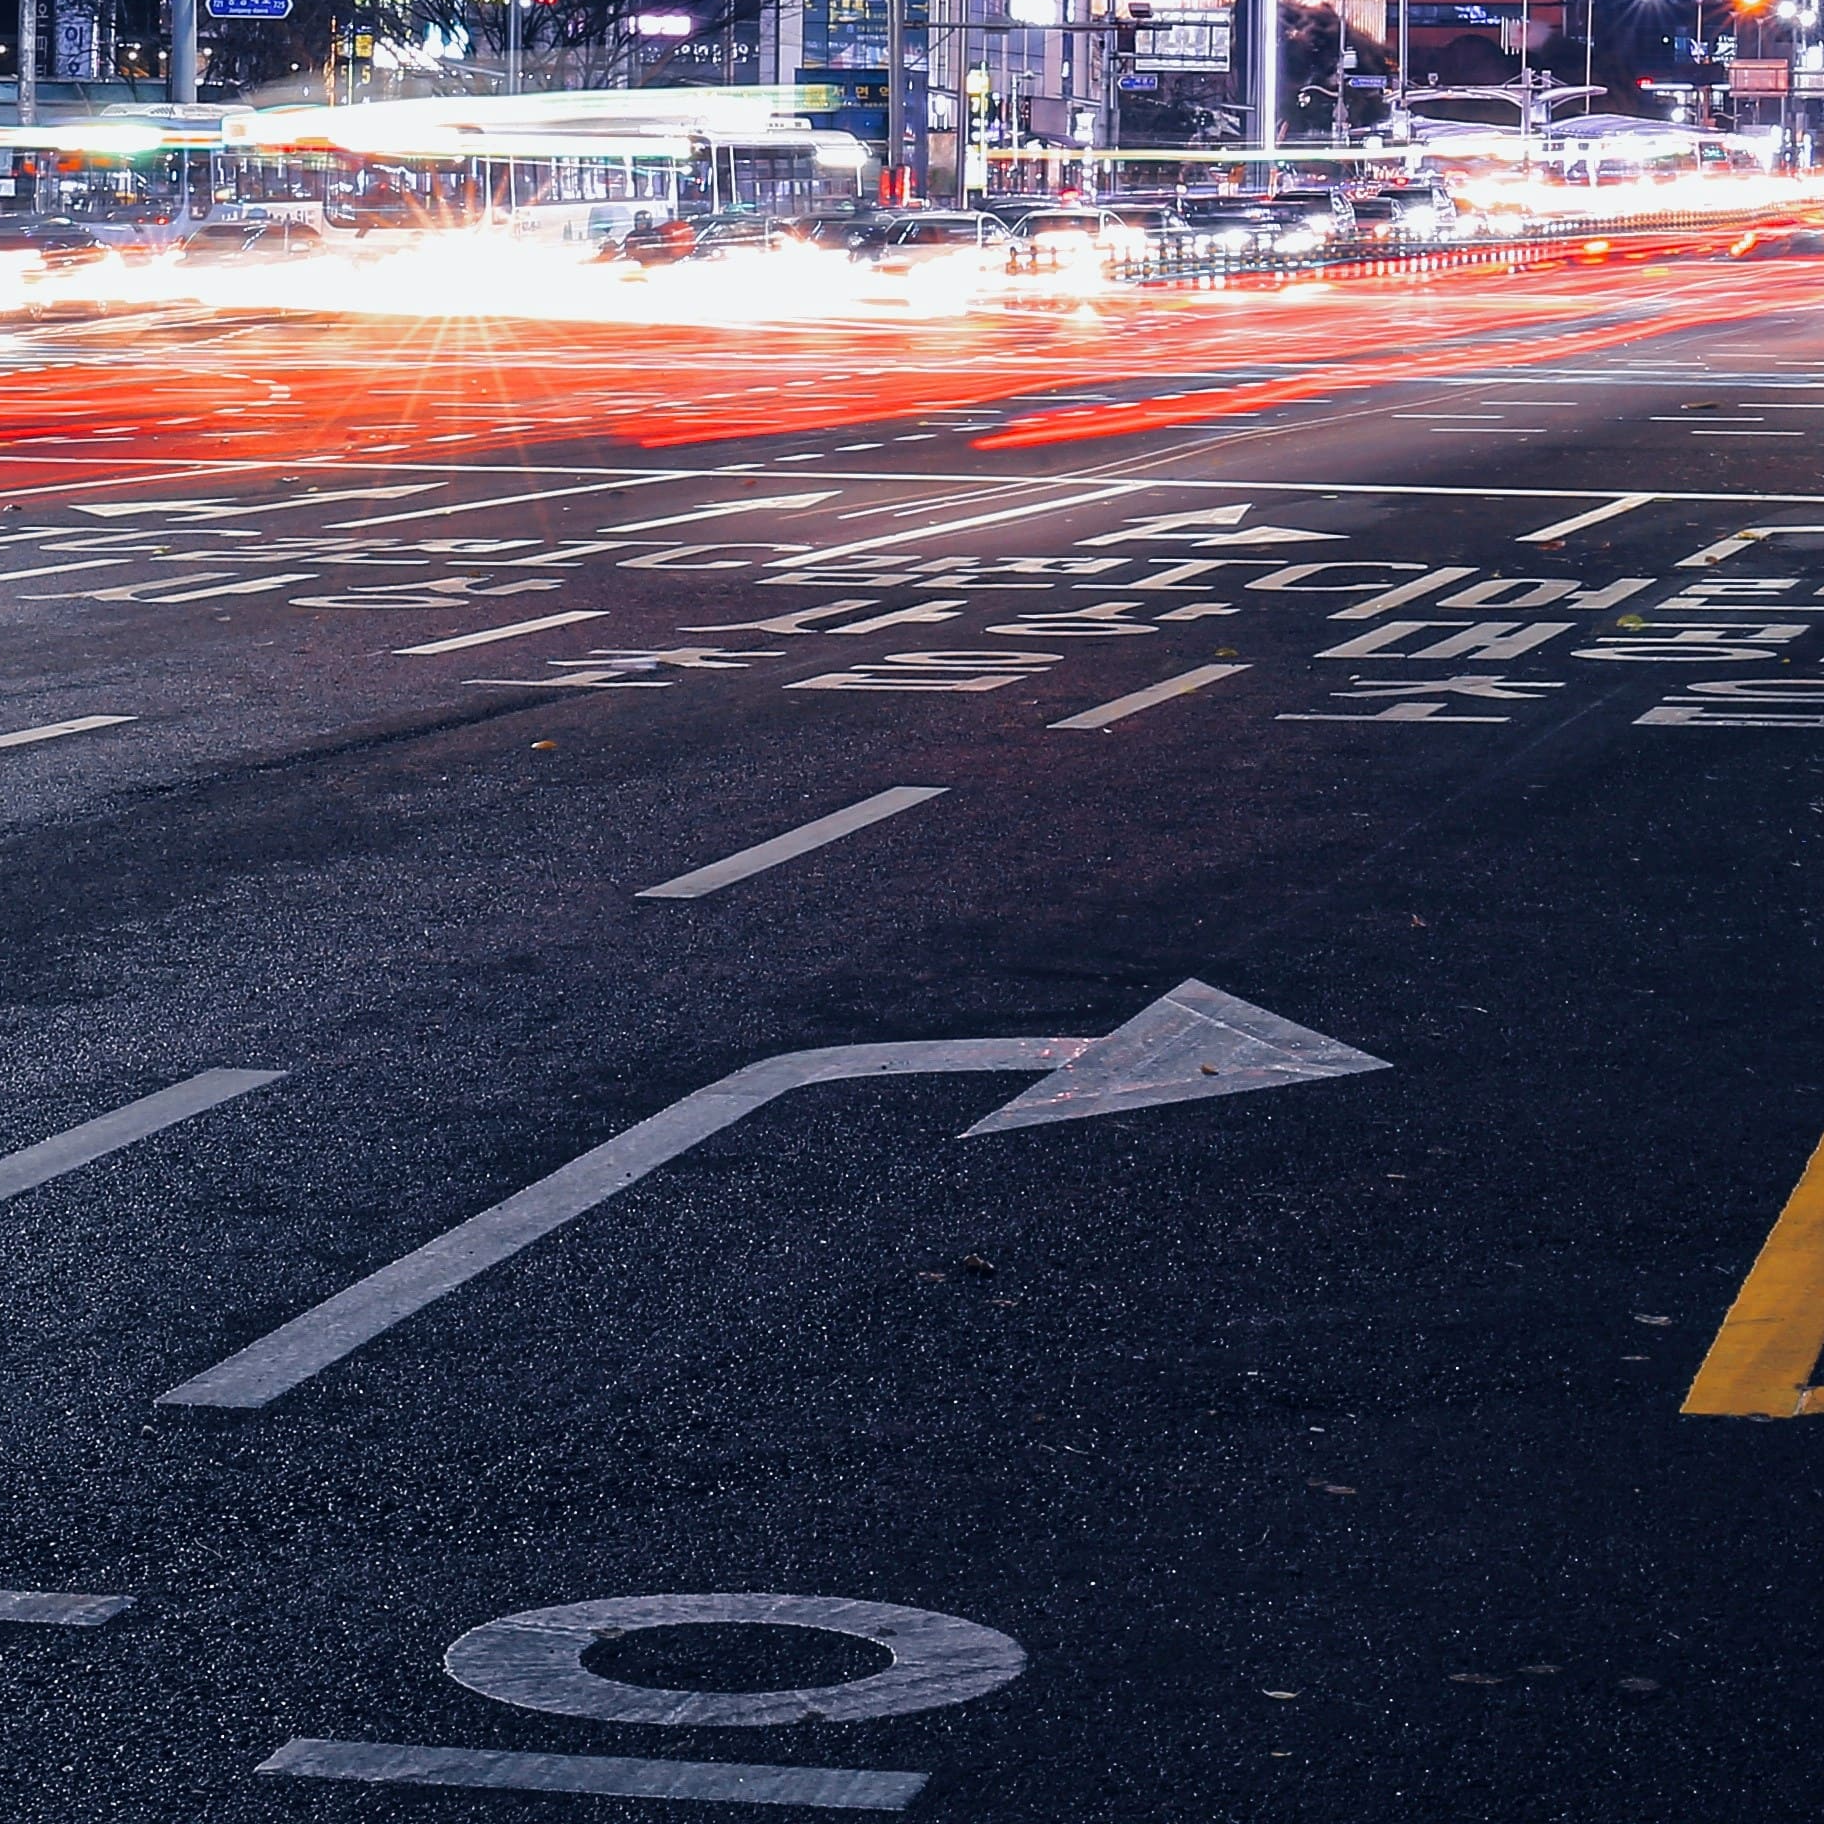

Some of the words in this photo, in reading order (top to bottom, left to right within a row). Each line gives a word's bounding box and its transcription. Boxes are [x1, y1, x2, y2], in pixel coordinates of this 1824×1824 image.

[16, 572, 566, 608] 사상
[755, 555, 1429, 591] 감전IC
[674, 598, 1241, 636] 사상
[461, 648, 1066, 691] 초읍
